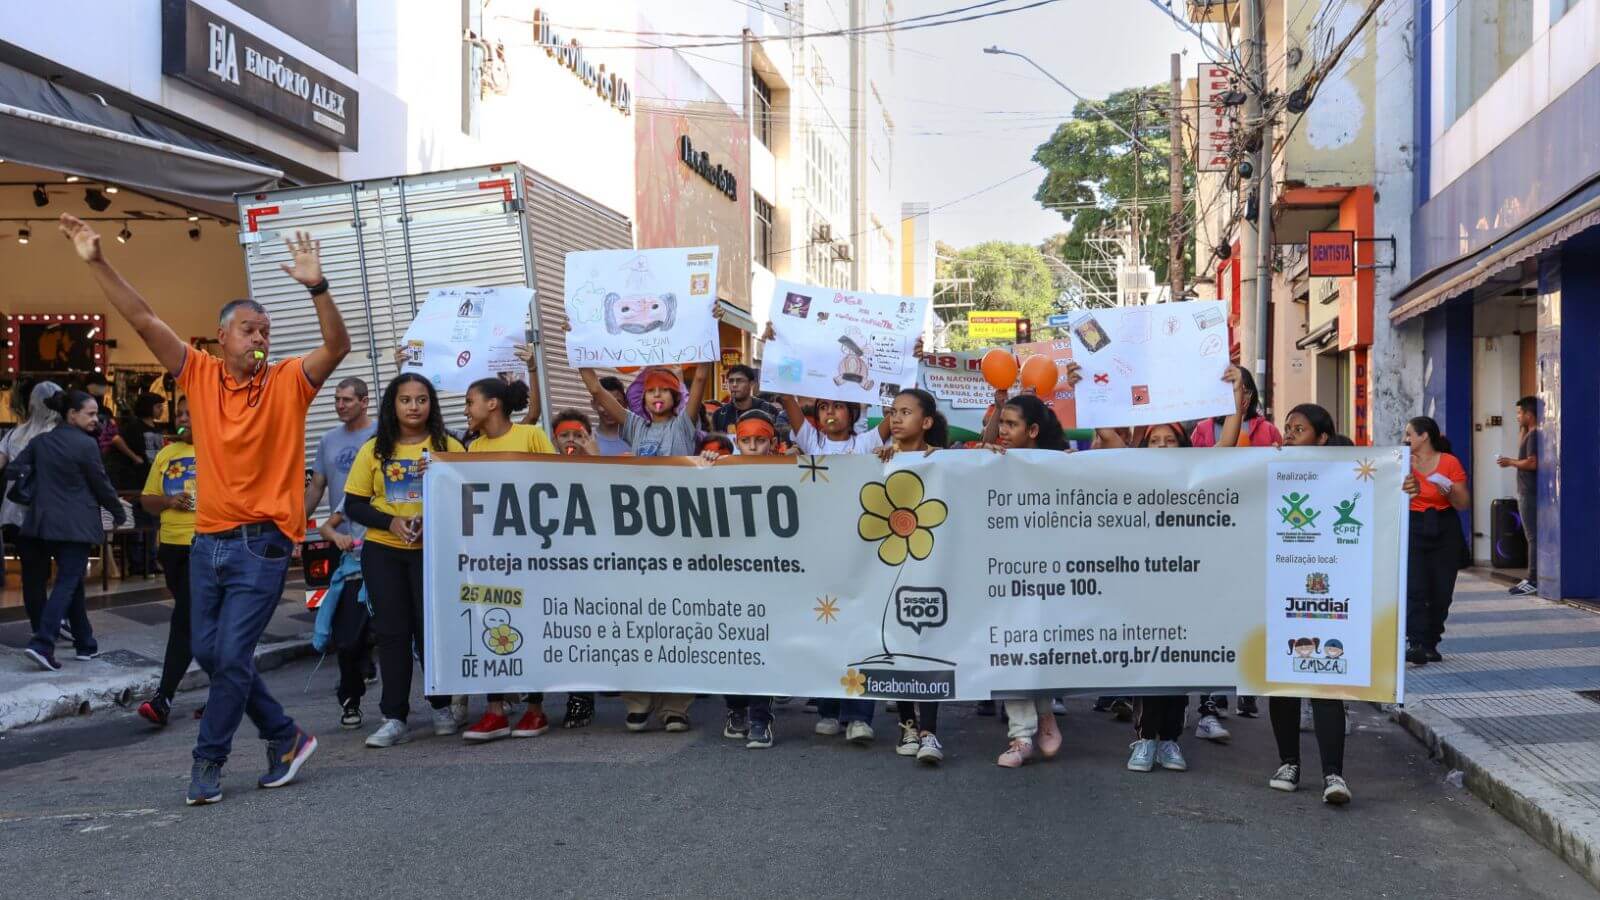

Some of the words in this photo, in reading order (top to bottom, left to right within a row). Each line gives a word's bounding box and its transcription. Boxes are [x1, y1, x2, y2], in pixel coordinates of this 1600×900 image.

[245, 46, 310, 100] EMPÓRIO
[312, 82, 346, 119] ALEX
[1313, 244, 1351, 262] DENTISTA
[925, 354, 957, 369] 18
[947, 375, 983, 383] NACIONA
[941, 389, 970, 397] SEXUAL
[1355, 364, 1366, 440] DENT
[1277, 472, 1318, 482] Realização:
[988, 490, 1012, 506] Por
[1018, 493, 1050, 505] uma
[1056, 489, 1118, 505] infância
[1124, 493, 1131, 505] e
[1137, 488, 1239, 505] adolescência
[462, 483, 596, 549] FAÇA
[610, 484, 799, 538] BONITO
[988, 516, 1018, 529] sem
[1024, 511, 1091, 528] violência
[1098, 511, 1149, 528] sexual,
[1156, 510, 1235, 527] denuncie.
[458, 553, 522, 576] Proteja
[528, 557, 588, 570] nossas
[594, 553, 667, 575] crianças
[673, 558, 682, 570] e
[688, 554, 805, 573] adolescentes.
[989, 558, 1047, 574] Procure
[1052, 561, 1061, 573] o
[1066, 556, 1139, 573] conselho
[1145, 555, 1200, 572] tutelar
[1276, 554, 1316, 565] Realização
[1318, 555, 1338, 563] local:
[461, 586, 479, 602] 25
[483, 588, 522, 605] ANOS
[988, 585, 1006, 597] ou
[1012, 580, 1065, 600] Disque
[1070, 579, 1101, 595] 100.
[544, 598, 567, 615] Dia
[575, 597, 642, 615] Nacional
[648, 598, 666, 615] de
[673, 598, 741, 617] Combate
[747, 604, 765, 617] ao
[904, 597, 940, 605] DISQUE
[1285, 597, 1349, 612] Jundiaí
[903, 605, 939, 618] 100
[461, 607, 523, 656] 18
[543, 621, 591, 639] Abuso
[598, 626, 606, 638] e
[612, 621, 620, 638] à
[627, 621, 712, 643] Exploração
[718, 623, 768, 641] Sexual
[990, 626, 997, 643] E
[1004, 630, 1037, 647] para
[1044, 625, 1094, 642] crimes
[1100, 628, 1117, 641] na
[1123, 624, 1186, 640] internet:
[544, 646, 562, 663] de
[569, 645, 639, 666] Crianças
[644, 651, 653, 662] e
[658, 646, 765, 665] Adolescentes.
[990, 646, 1235, 668] new.safernet.org.br/denuncie
[462, 658, 478, 677] DE
[484, 658, 523, 677] MAIO
[1300, 658, 1343, 674] CMDCA
[867, 676, 950, 697] facabonito.org
